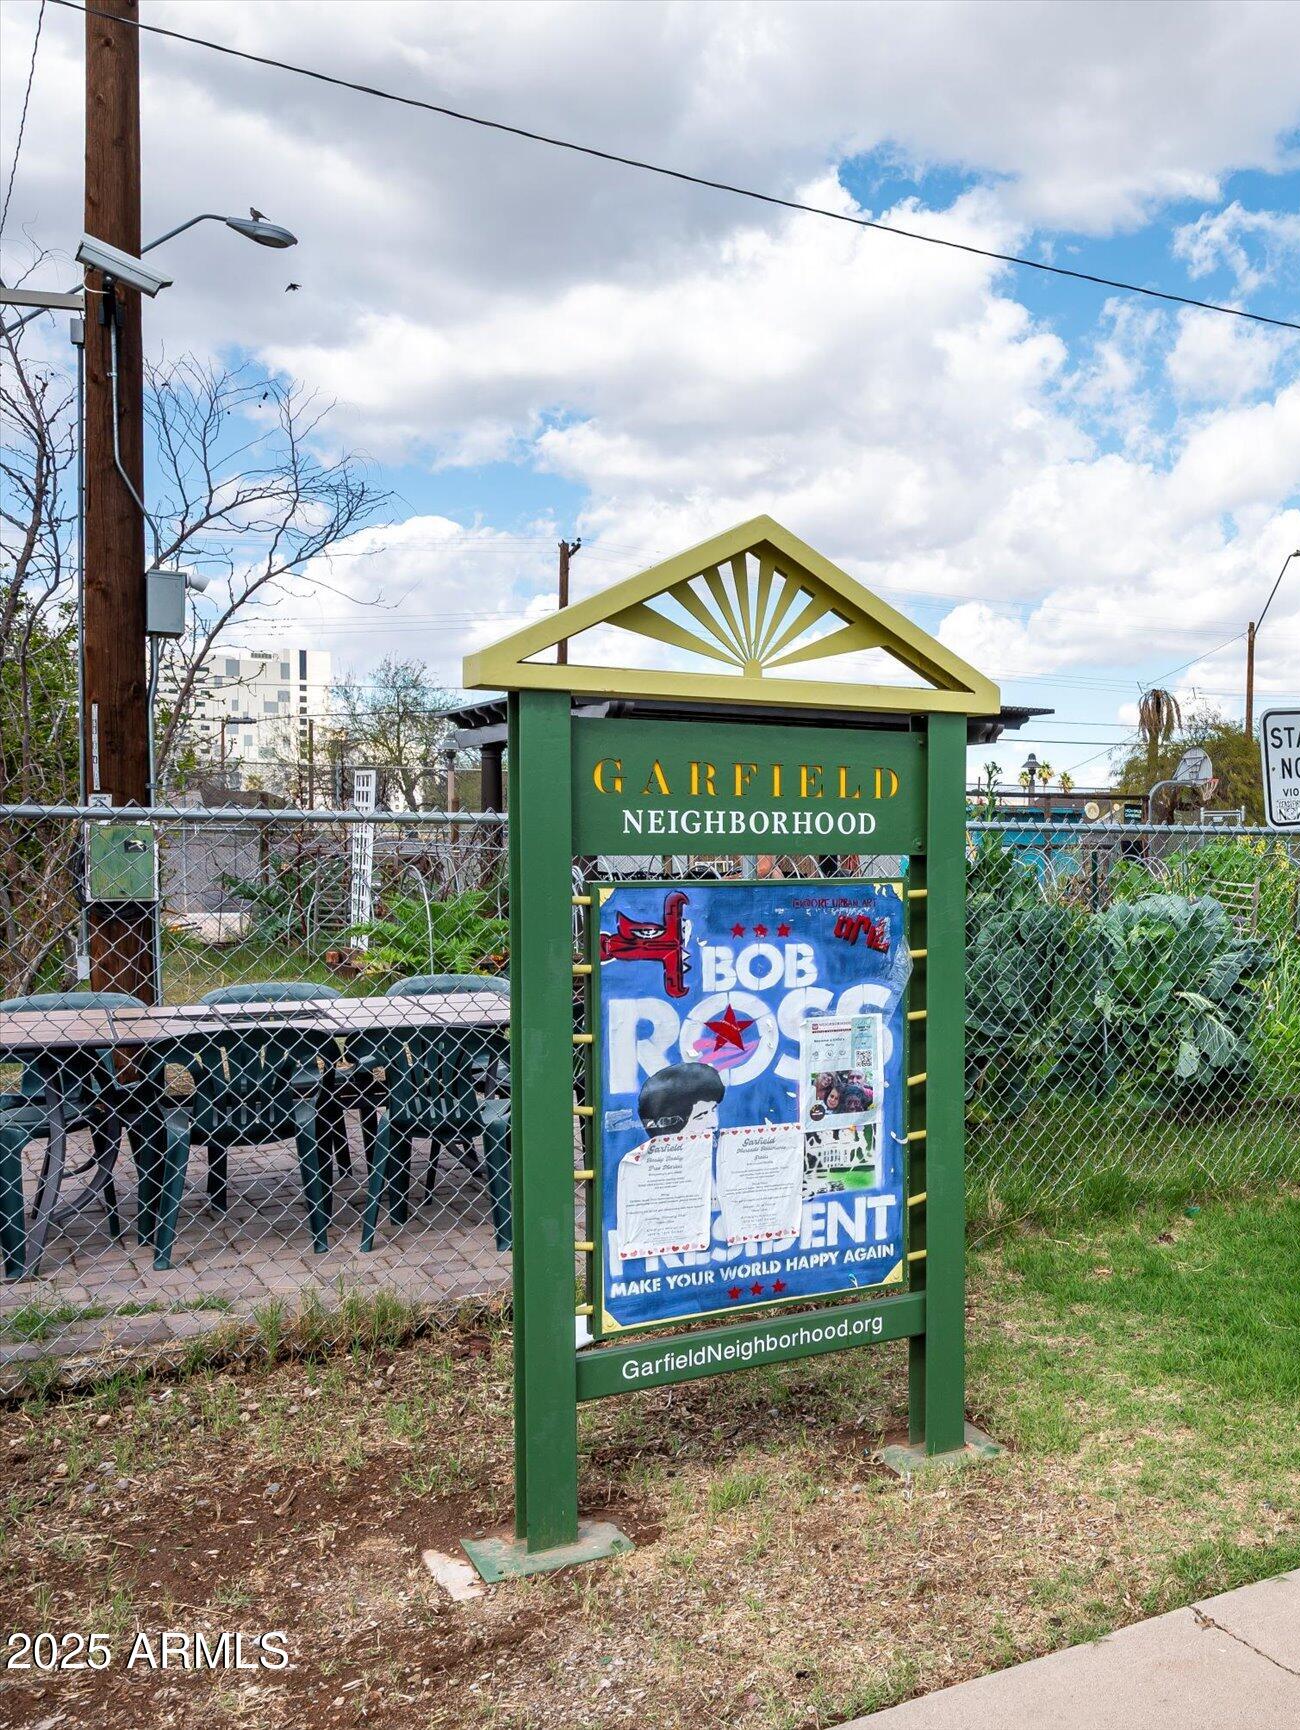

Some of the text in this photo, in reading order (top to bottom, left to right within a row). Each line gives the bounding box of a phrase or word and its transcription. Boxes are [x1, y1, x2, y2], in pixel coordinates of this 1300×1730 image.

[592, 758, 900, 800] GARFIELD
[622, 808, 877, 835] NEIGHBORHOOD
[701, 942, 818, 992] BOB
[608, 983, 894, 1095] ROSS
[610, 1243, 895, 1299] MAKE YOUR WORLD HAPPY AGAIN
[621, 1314, 884, 1381] GarfieldNeighborhood.org
